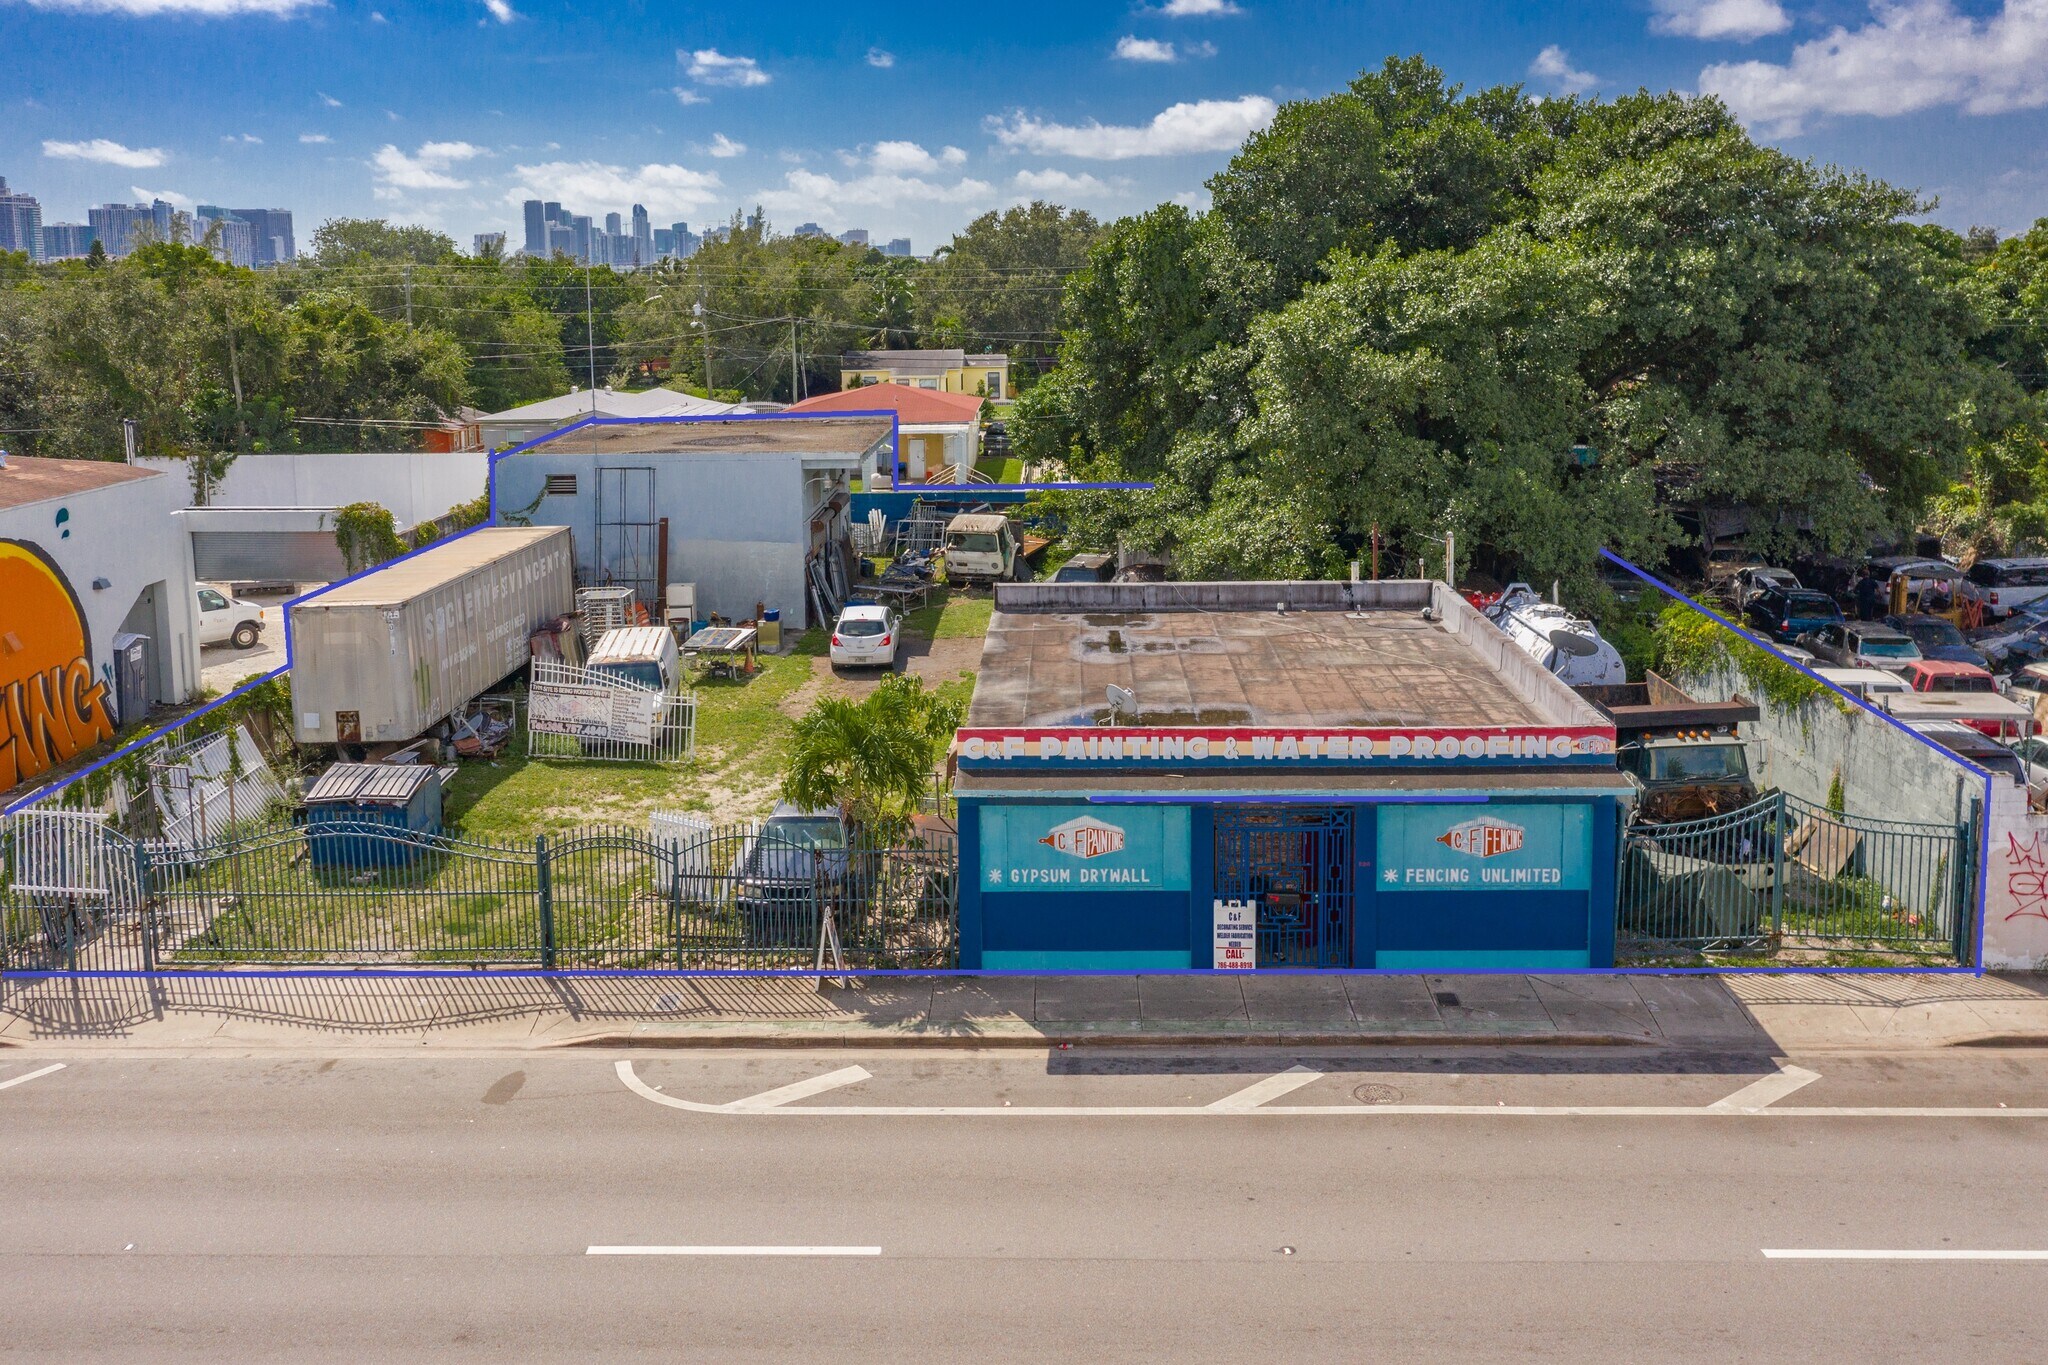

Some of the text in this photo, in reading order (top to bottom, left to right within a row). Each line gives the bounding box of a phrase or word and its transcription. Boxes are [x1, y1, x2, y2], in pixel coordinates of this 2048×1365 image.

[424, 584, 490, 641] SOCIETY
[509, 551, 560, 594] VINCENT
[580, 717, 608, 725] BUSINESS
[963, 737, 1025, 761] C&F
[1040, 736, 1209, 761] PAINTING
[1224, 736, 1240, 761] &
[1252, 736, 1375, 760] WATER
[1389, 735, 1572, 759] PROOFING
[1087, 827, 1123, 857] PAINTING
[1484, 826, 1523, 856] FENCING
[1011, 868, 1150, 883] GYPSUM DRYWALL
[1406, 868, 1561, 883] FENCING UNLIMITED
[1226, 949, 1244, 959] CALL:
